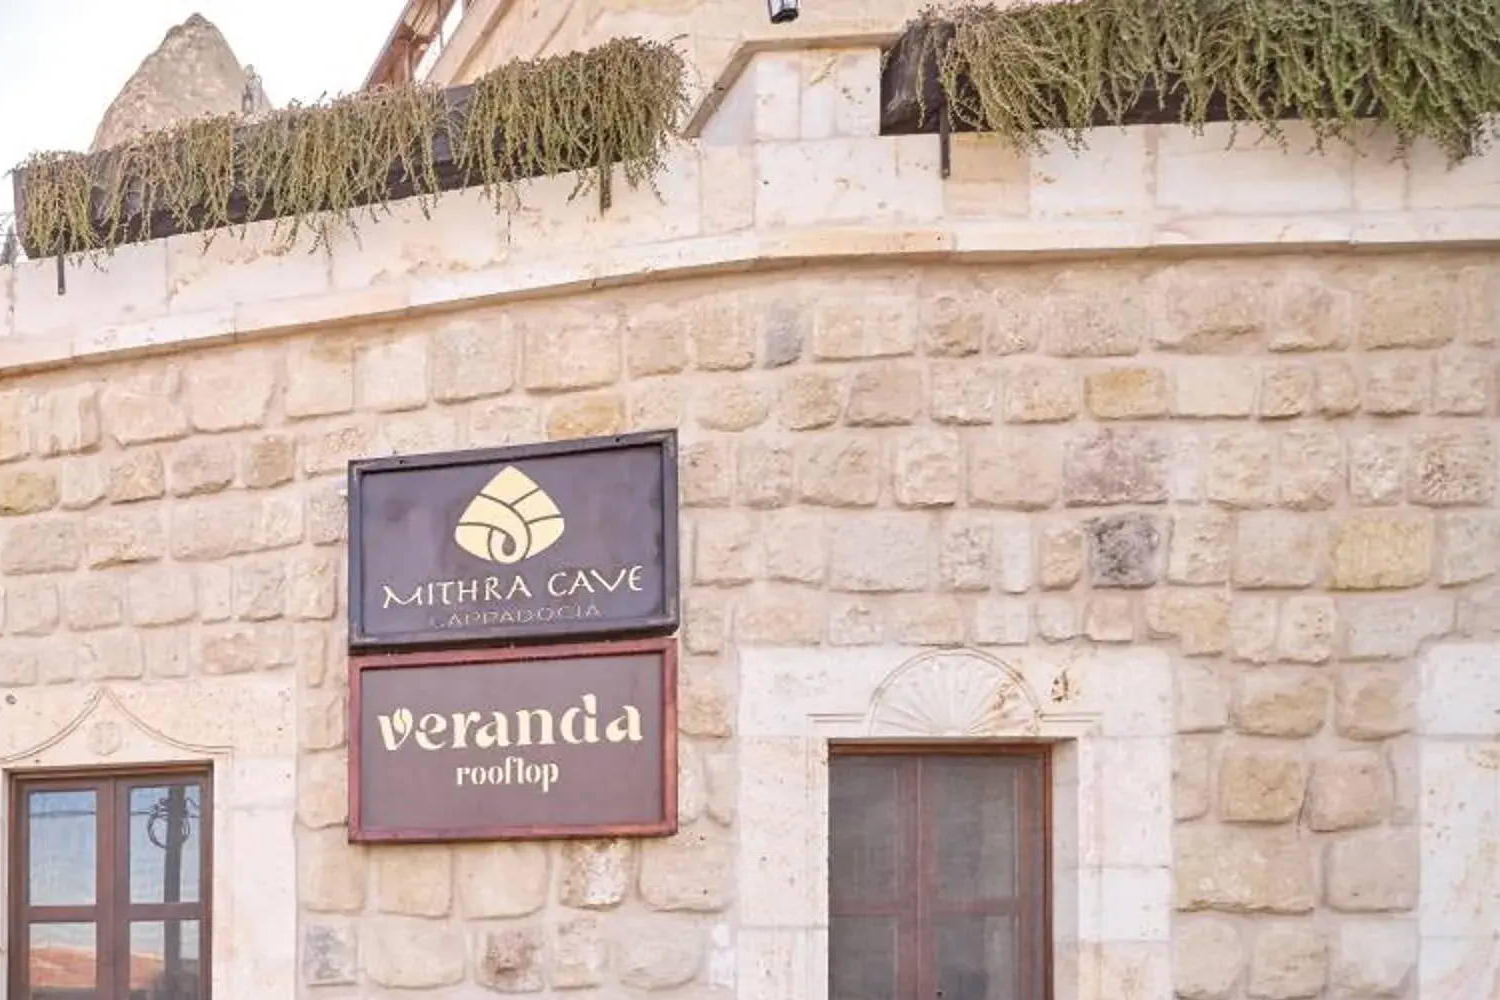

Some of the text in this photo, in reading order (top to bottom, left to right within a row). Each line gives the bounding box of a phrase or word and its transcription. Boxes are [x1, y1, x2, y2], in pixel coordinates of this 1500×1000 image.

[382, 564, 644, 609] MITHRA CAVE
[377, 693, 644, 752] veranda
[456, 755, 560, 793] rooftop
